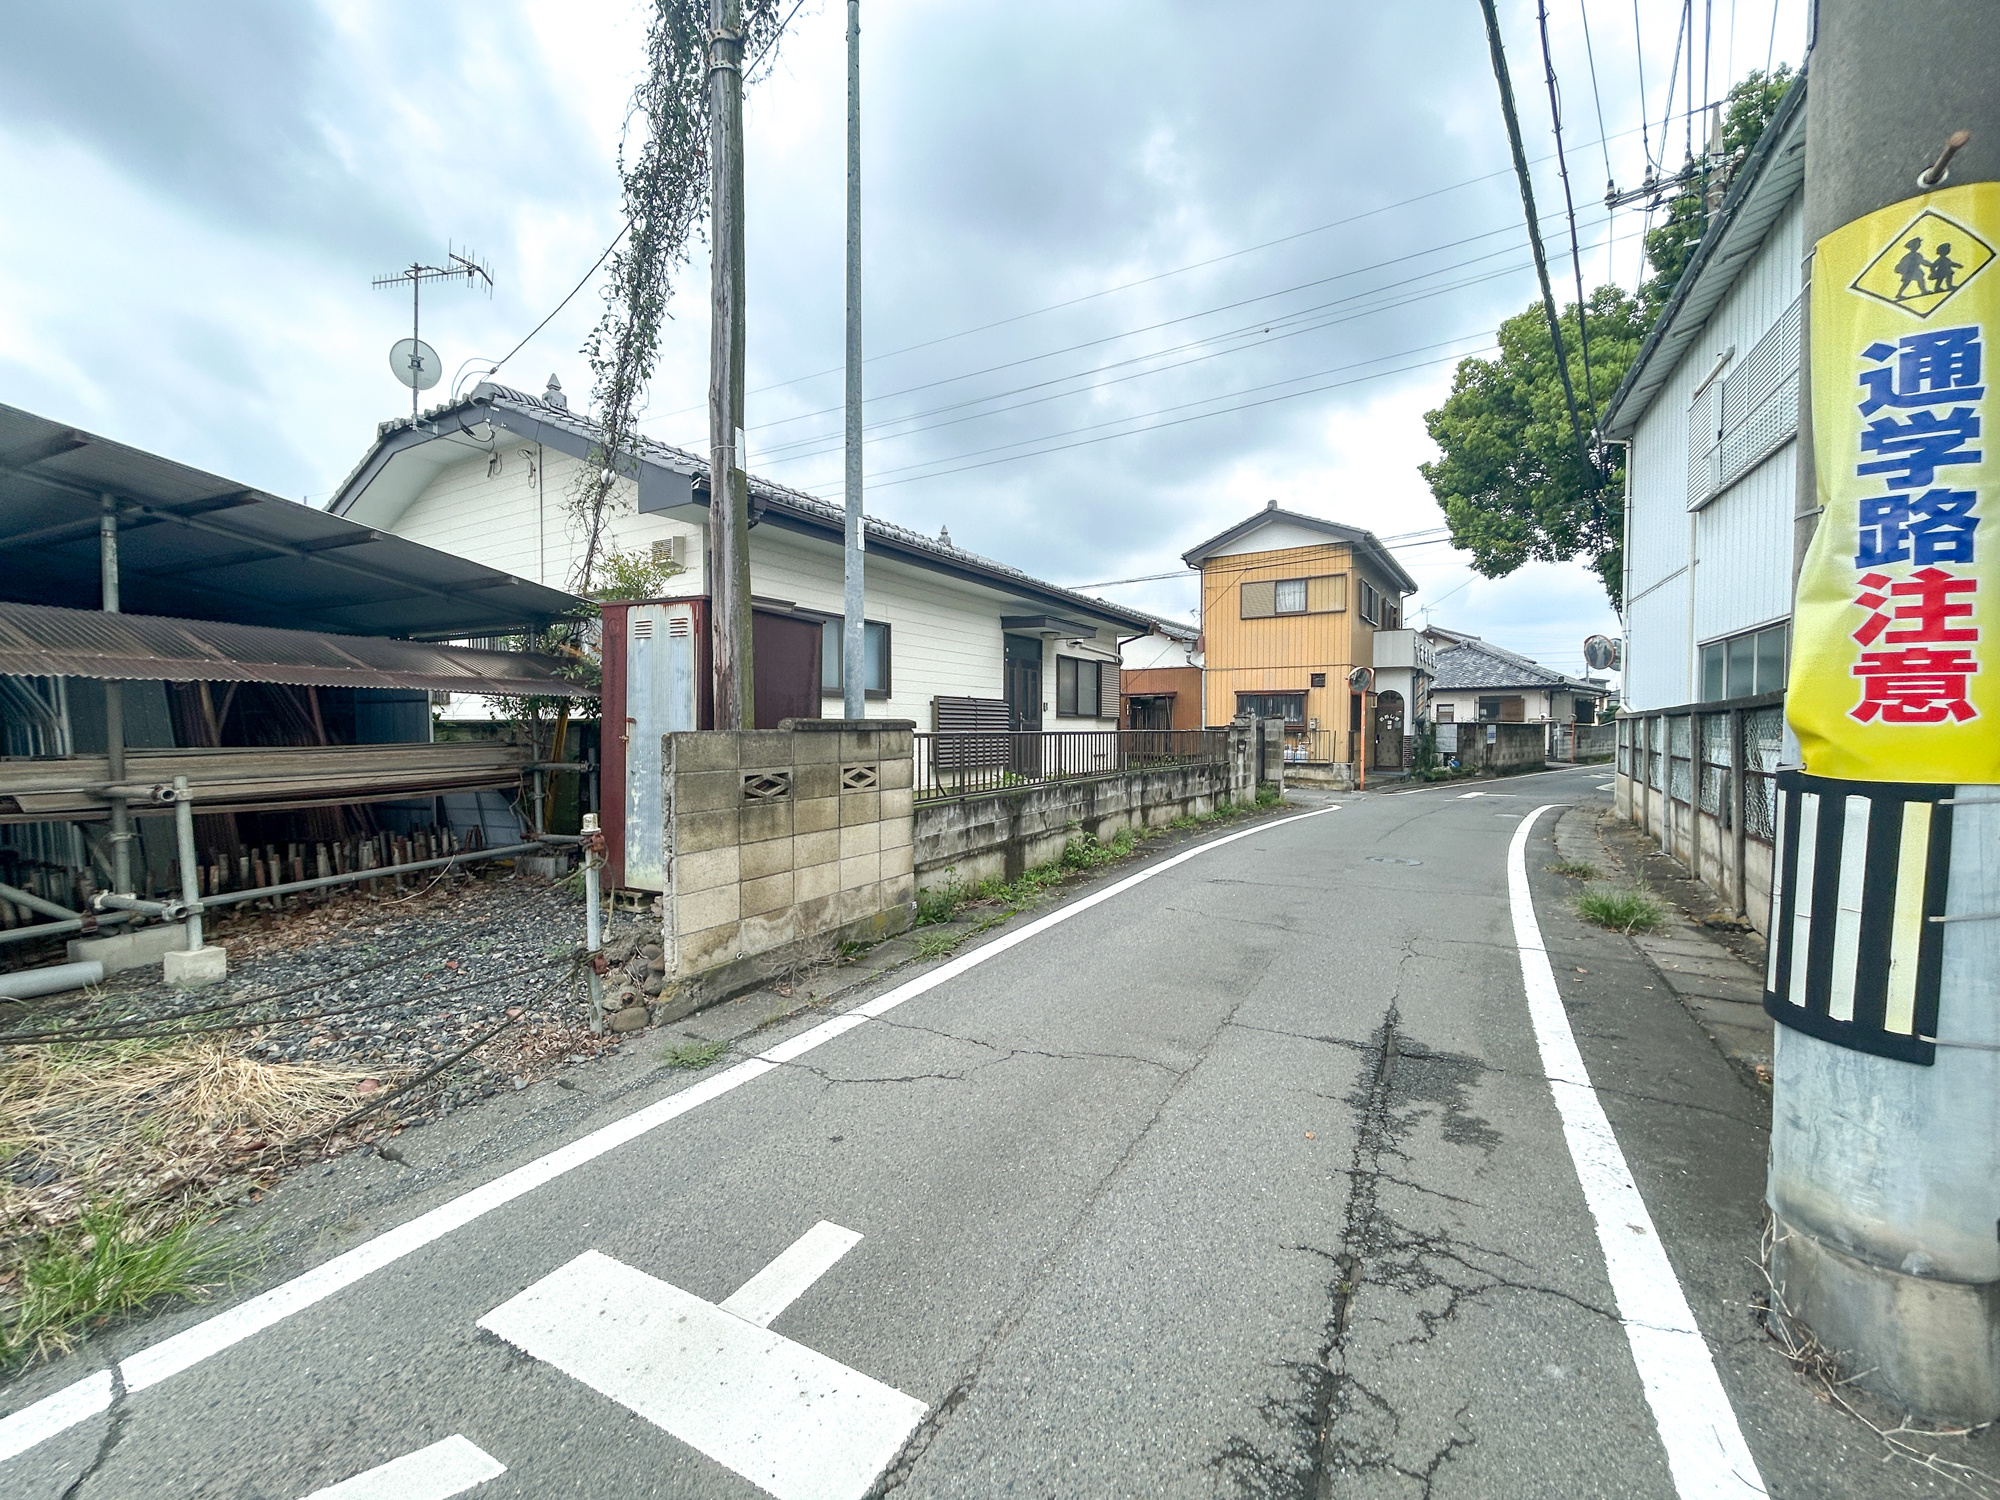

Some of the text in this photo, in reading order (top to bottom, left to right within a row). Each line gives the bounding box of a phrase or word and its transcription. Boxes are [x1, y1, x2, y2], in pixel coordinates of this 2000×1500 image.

[1851, 326, 1985, 723] 通学路注意
